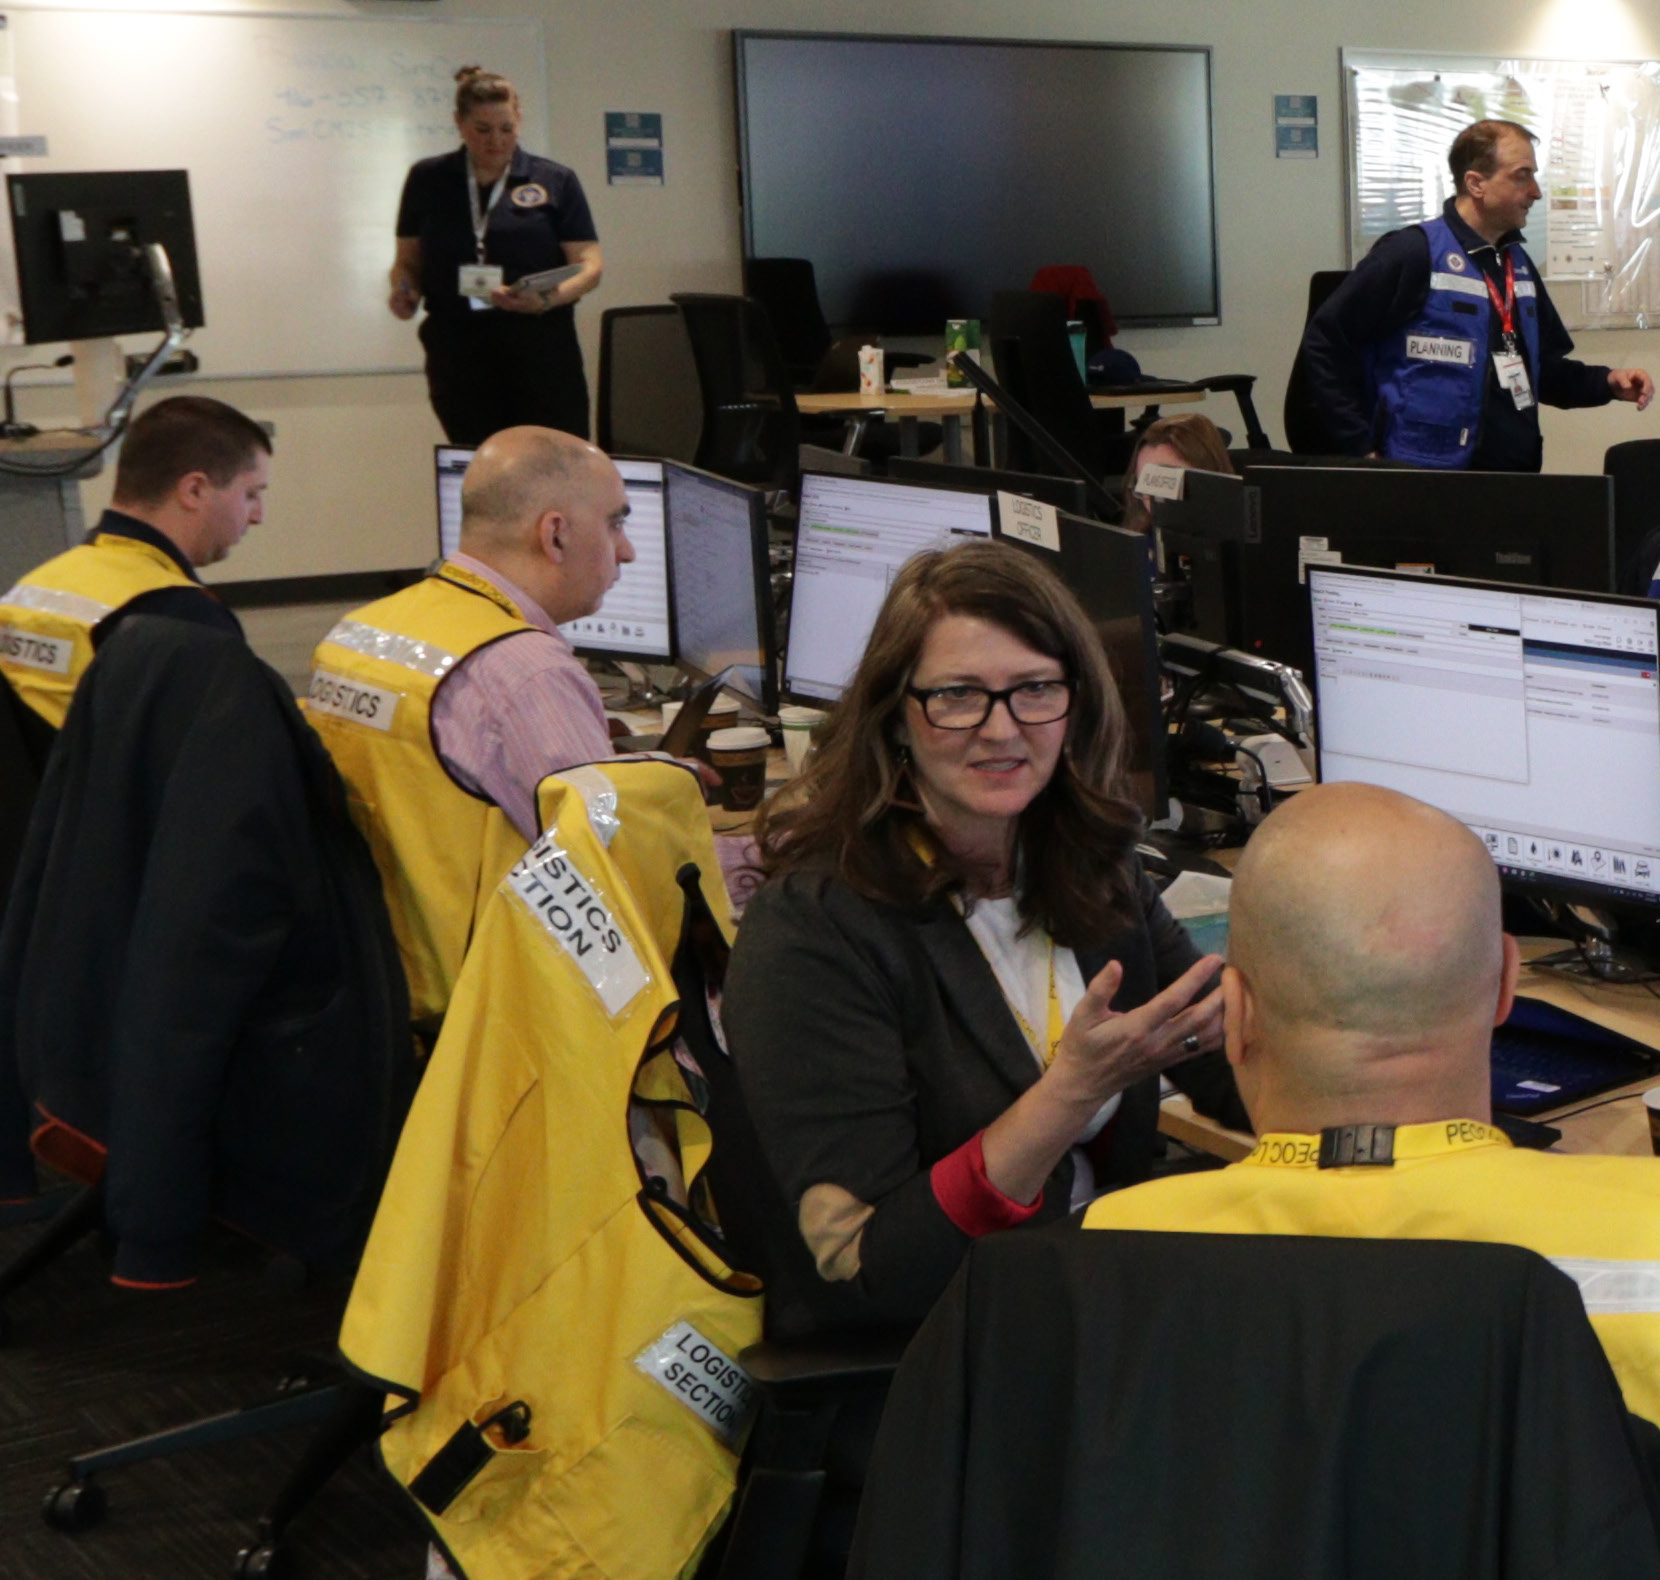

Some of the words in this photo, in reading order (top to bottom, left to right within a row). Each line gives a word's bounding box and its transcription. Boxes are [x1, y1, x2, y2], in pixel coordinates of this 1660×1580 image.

[1410, 340, 1462, 359] PLANNING
[308, 676, 382, 719] OGISTICS
[510, 859, 593, 957] CTION
[530, 835, 622, 953] ISTICS
[664, 1362, 735, 1425] SECTIO
[675, 1332, 750, 1402] LOGIST
